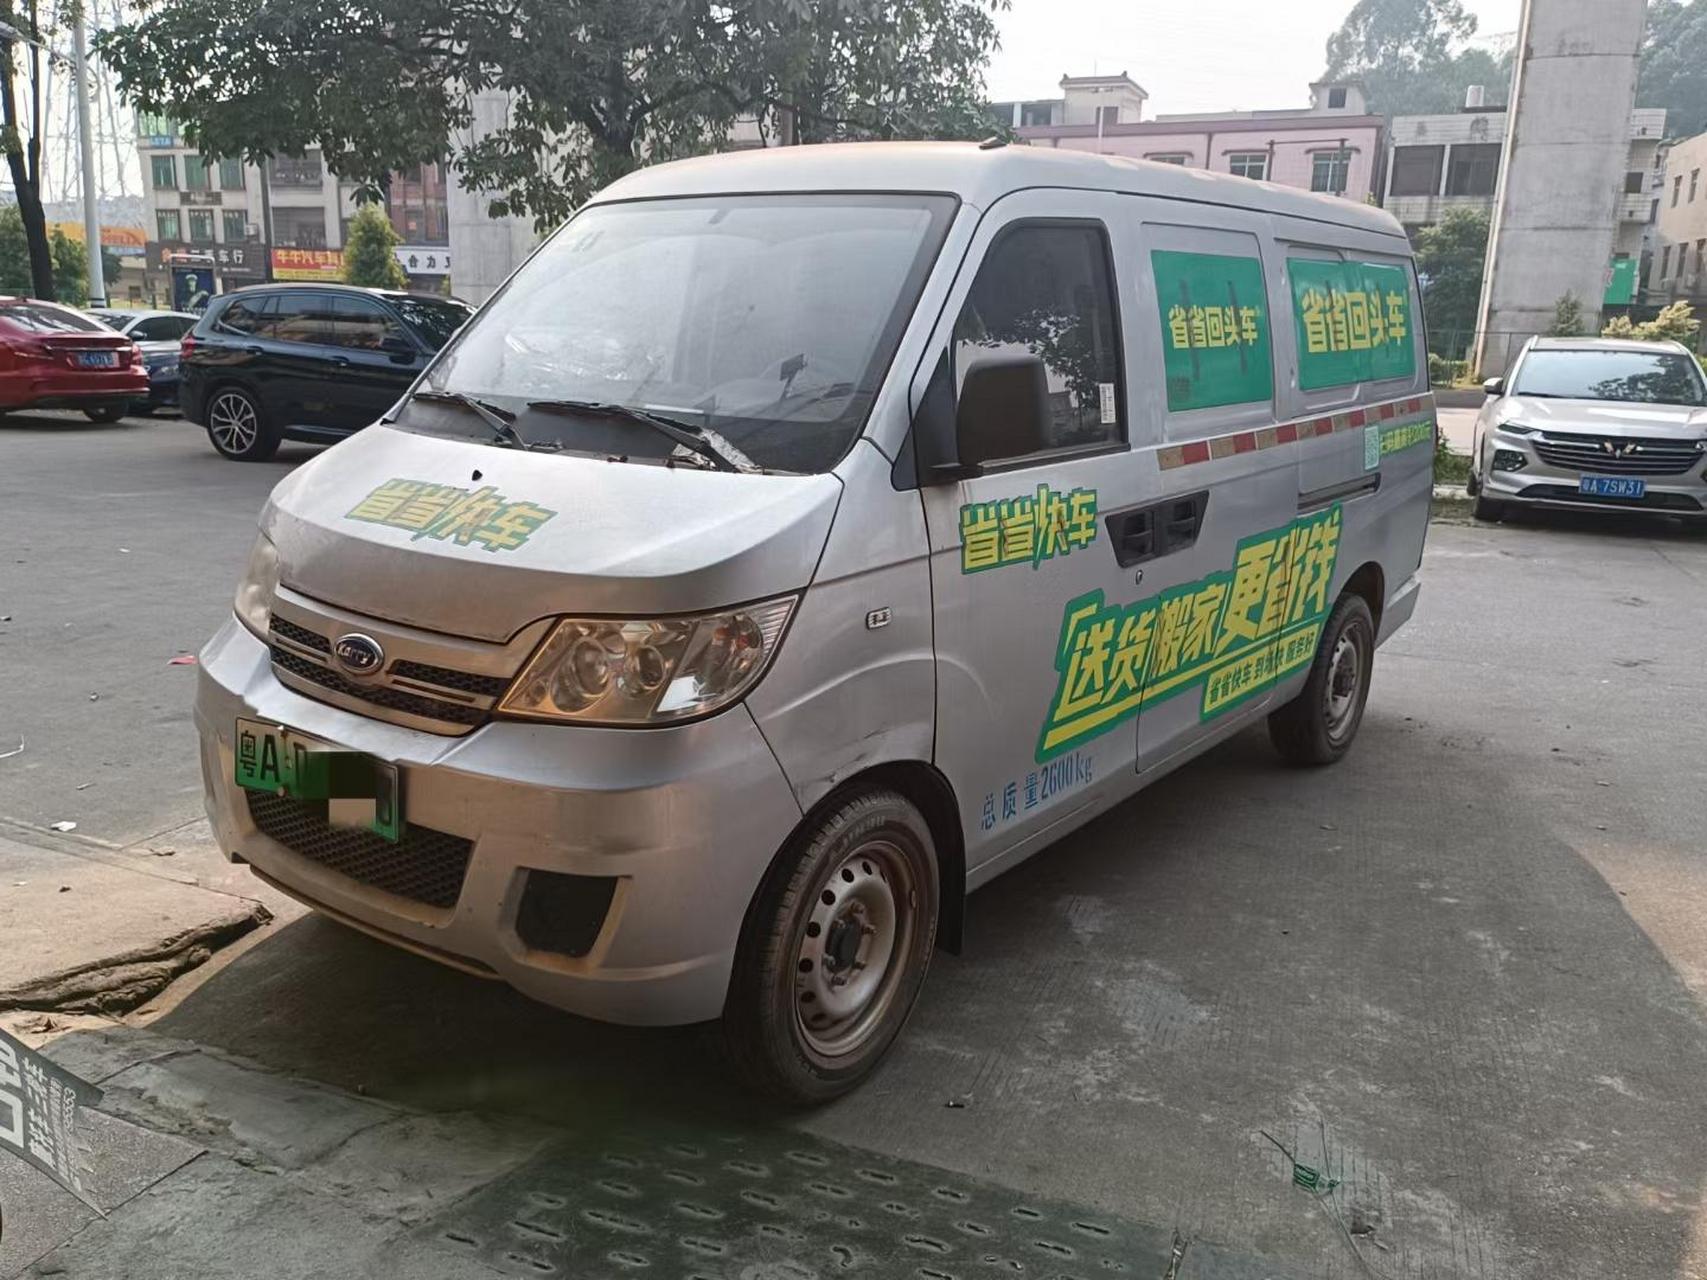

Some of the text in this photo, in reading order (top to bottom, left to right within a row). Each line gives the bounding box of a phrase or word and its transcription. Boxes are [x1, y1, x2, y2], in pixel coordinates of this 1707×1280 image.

[1168, 304, 1259, 349] 省省回头车
[1302, 289, 1406, 353] 省省回头车
[346, 480, 557, 551] 省省快车
[961, 487, 1096, 567] 省省快车
